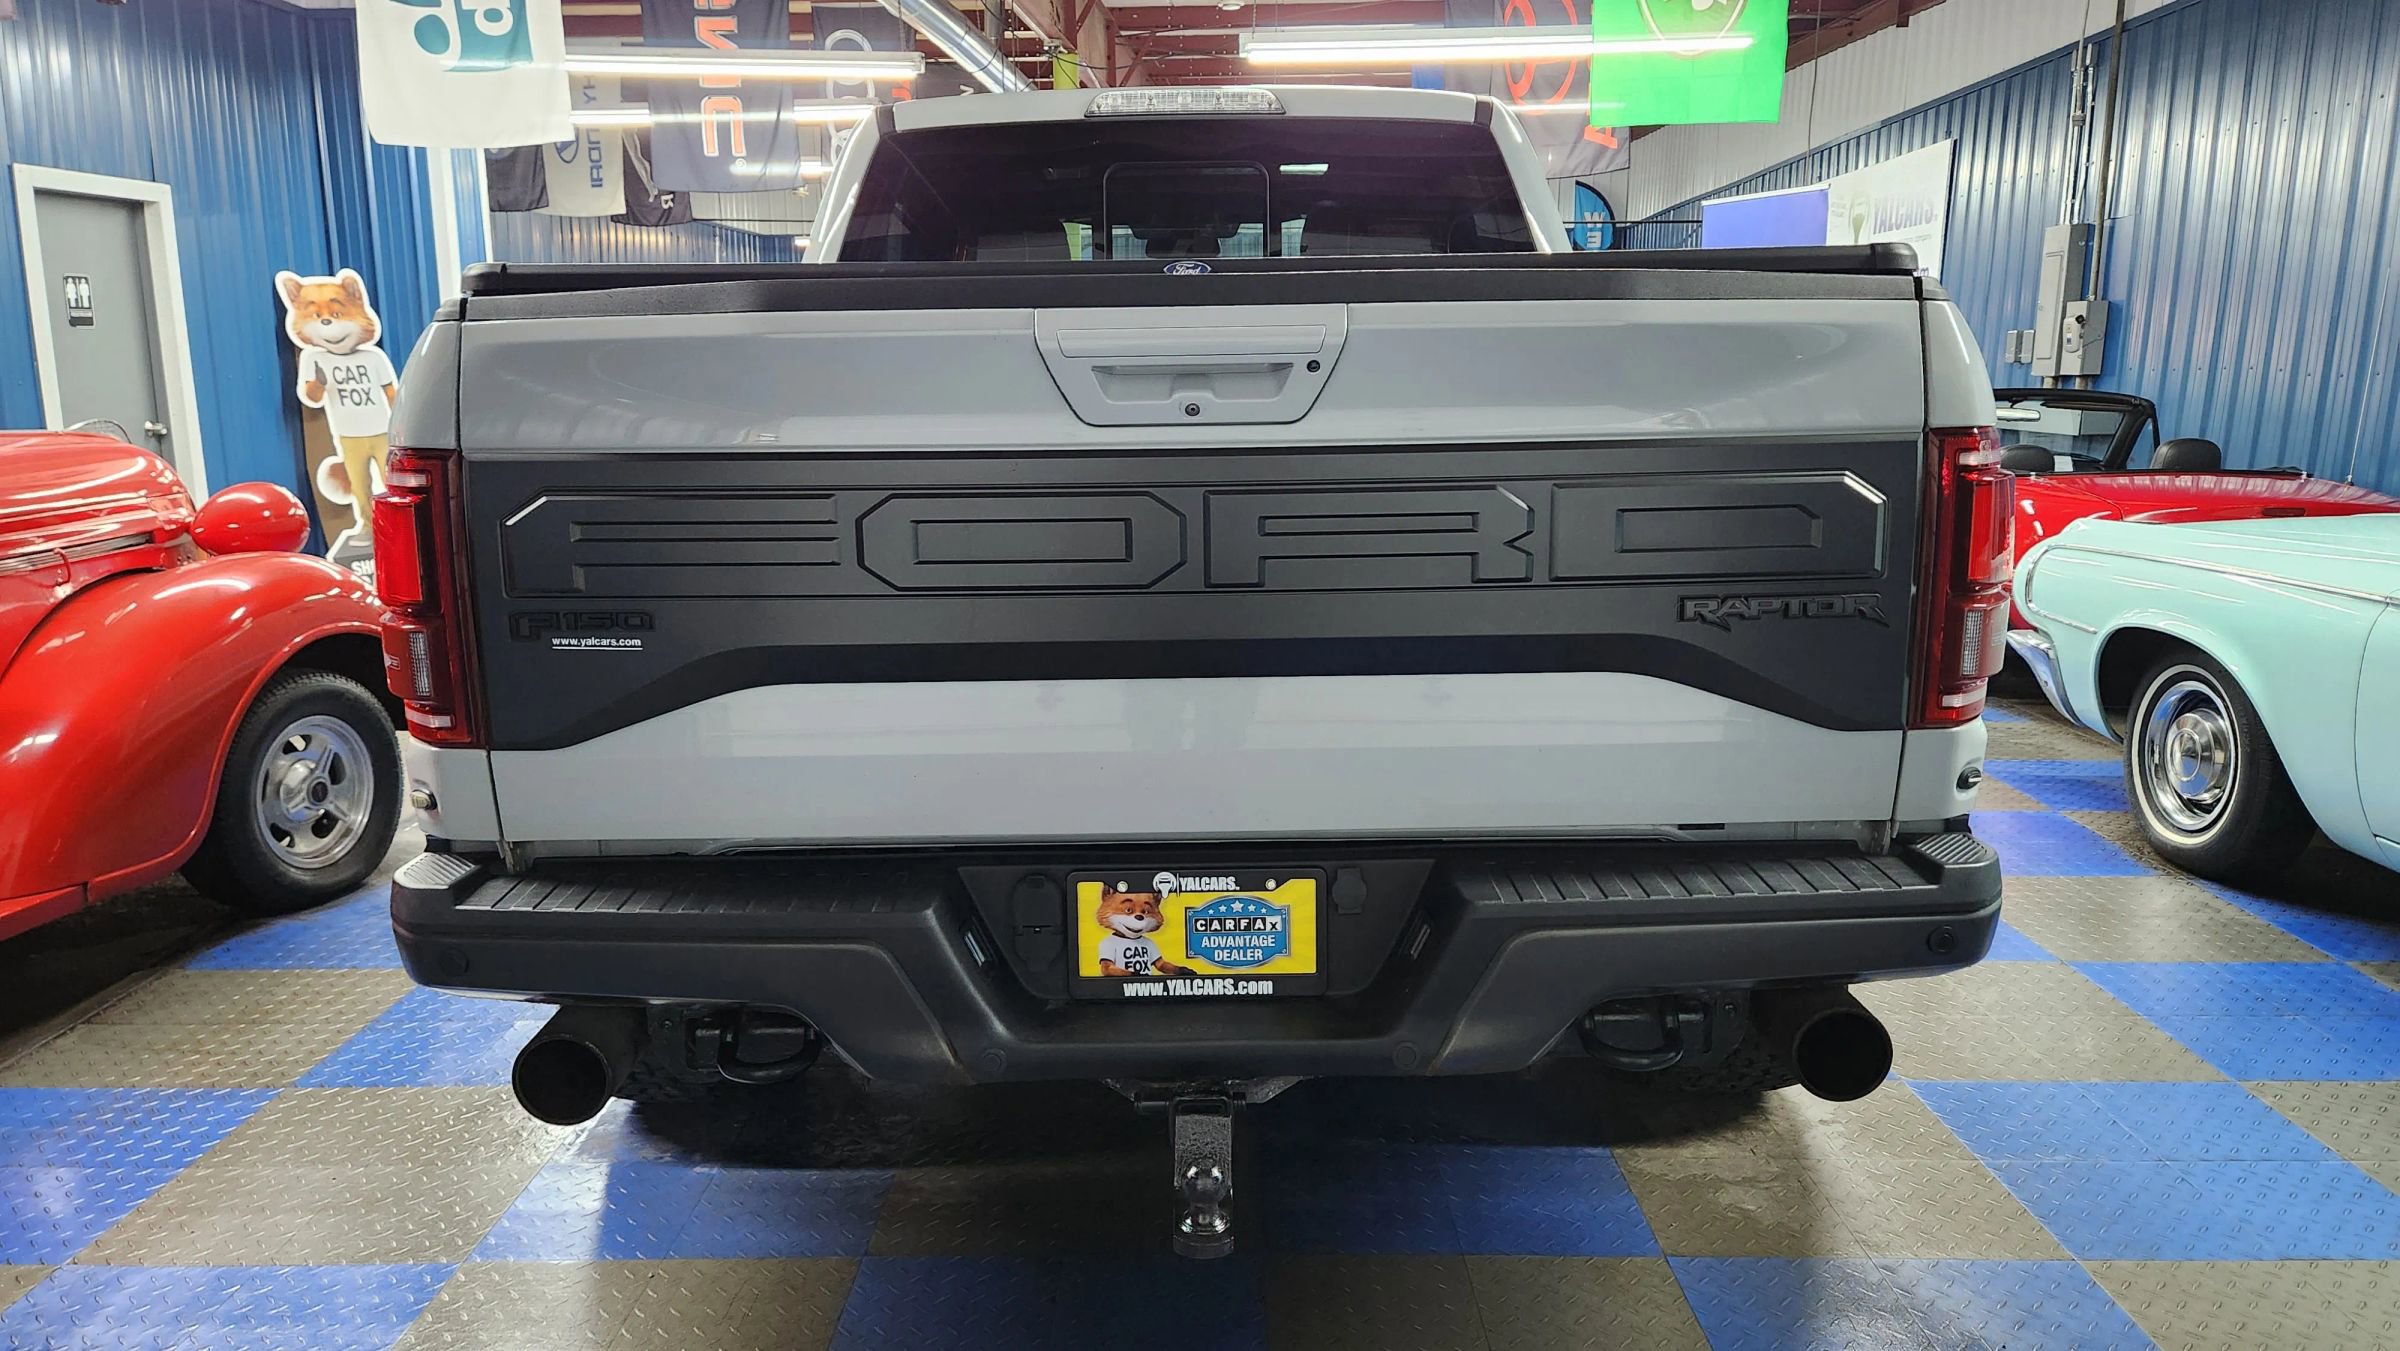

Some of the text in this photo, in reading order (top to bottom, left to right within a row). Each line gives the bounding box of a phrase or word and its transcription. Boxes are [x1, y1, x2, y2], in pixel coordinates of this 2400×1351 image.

[1173, 264, 1202, 275] Ford
[332, 365, 371, 385] CAR
[338, 387, 376, 407] FOX
[502, 473, 1885, 594] FORD
[1678, 594, 1890, 632] RAPTOR
[551, 637, 642, 646] www.yalcars.com
[1196, 919, 1279, 931] CARFAX
[1201, 935, 1276, 948] ADVANTAGE
[1123, 946, 1149, 960] CAR
[1214, 949, 1263, 961] DEALER
[1124, 960, 1151, 972] FOX
[1123, 978, 1273, 997] www.YALCARS.com
